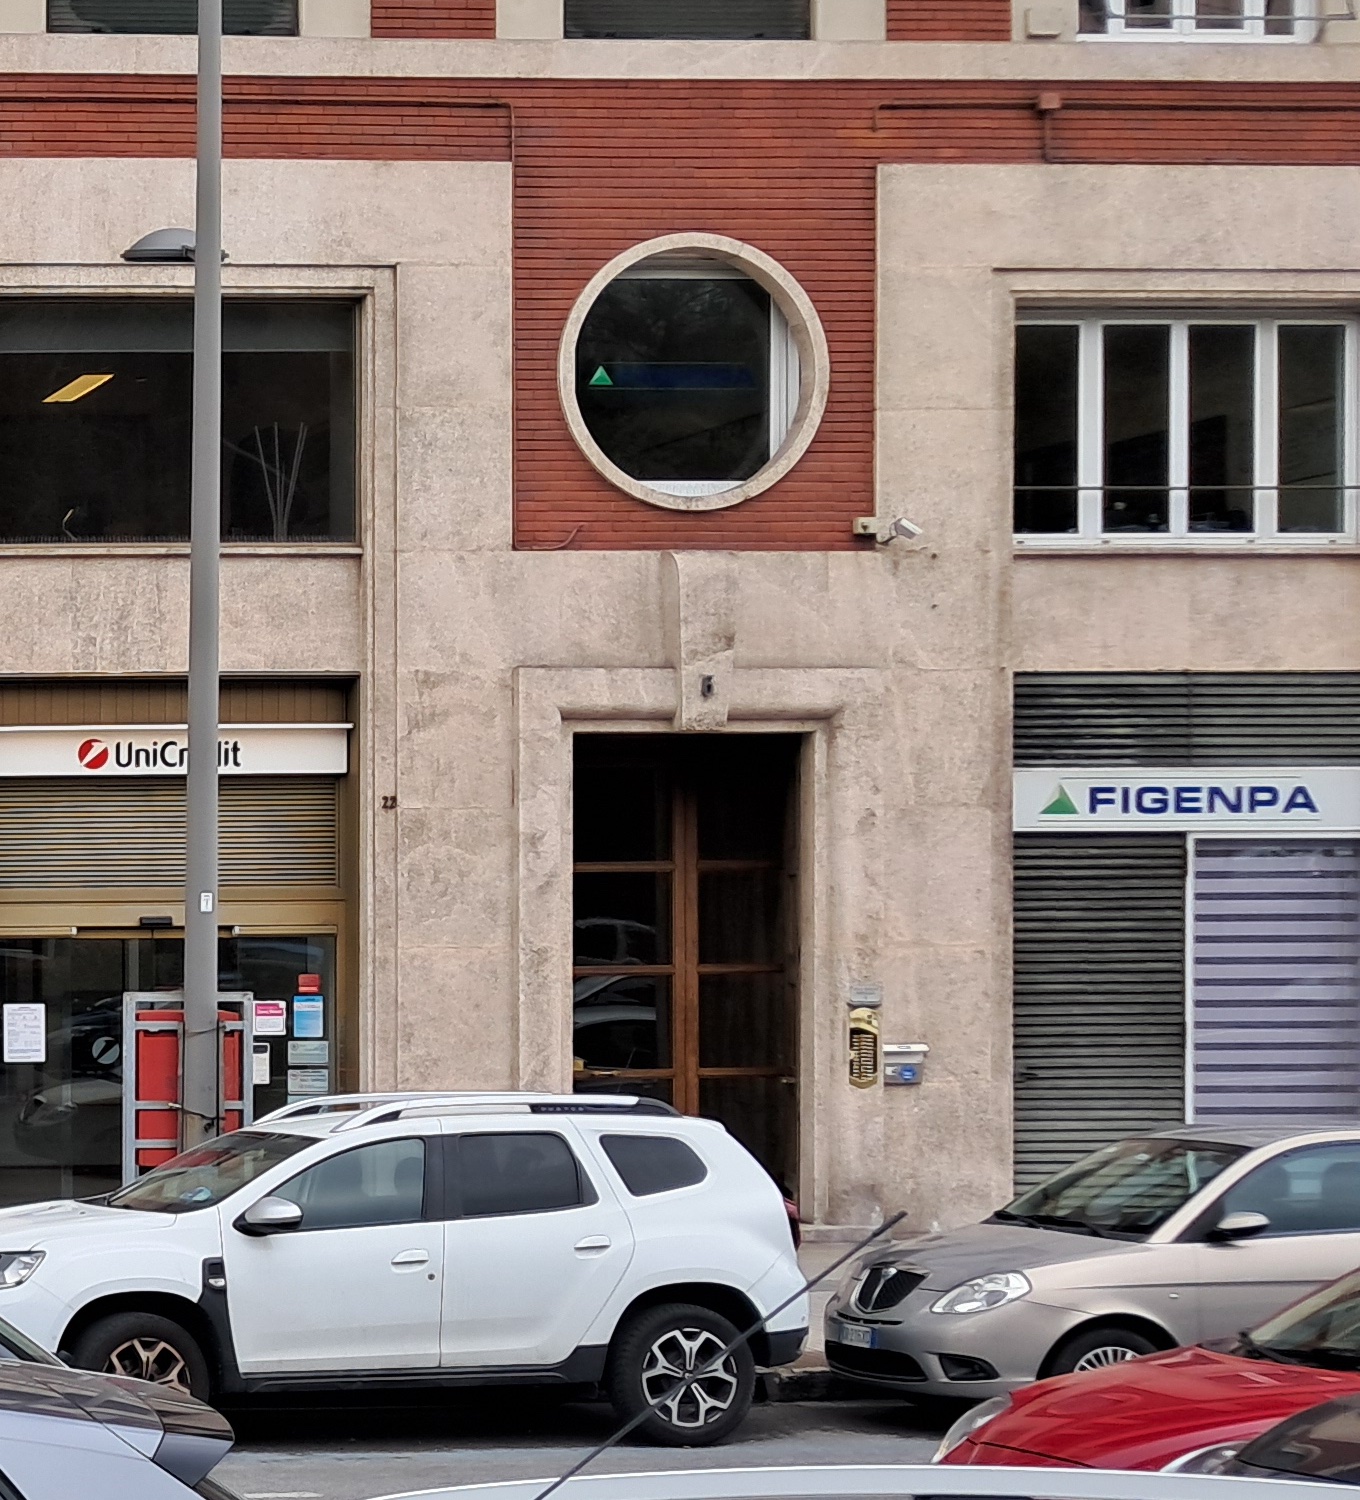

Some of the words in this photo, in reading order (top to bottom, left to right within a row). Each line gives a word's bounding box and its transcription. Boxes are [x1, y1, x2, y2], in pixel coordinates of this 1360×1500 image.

[115, 740, 241, 768] UniCrit
[381, 795, 397, 810] 22
[1088, 786, 1320, 814] FIGENPA
